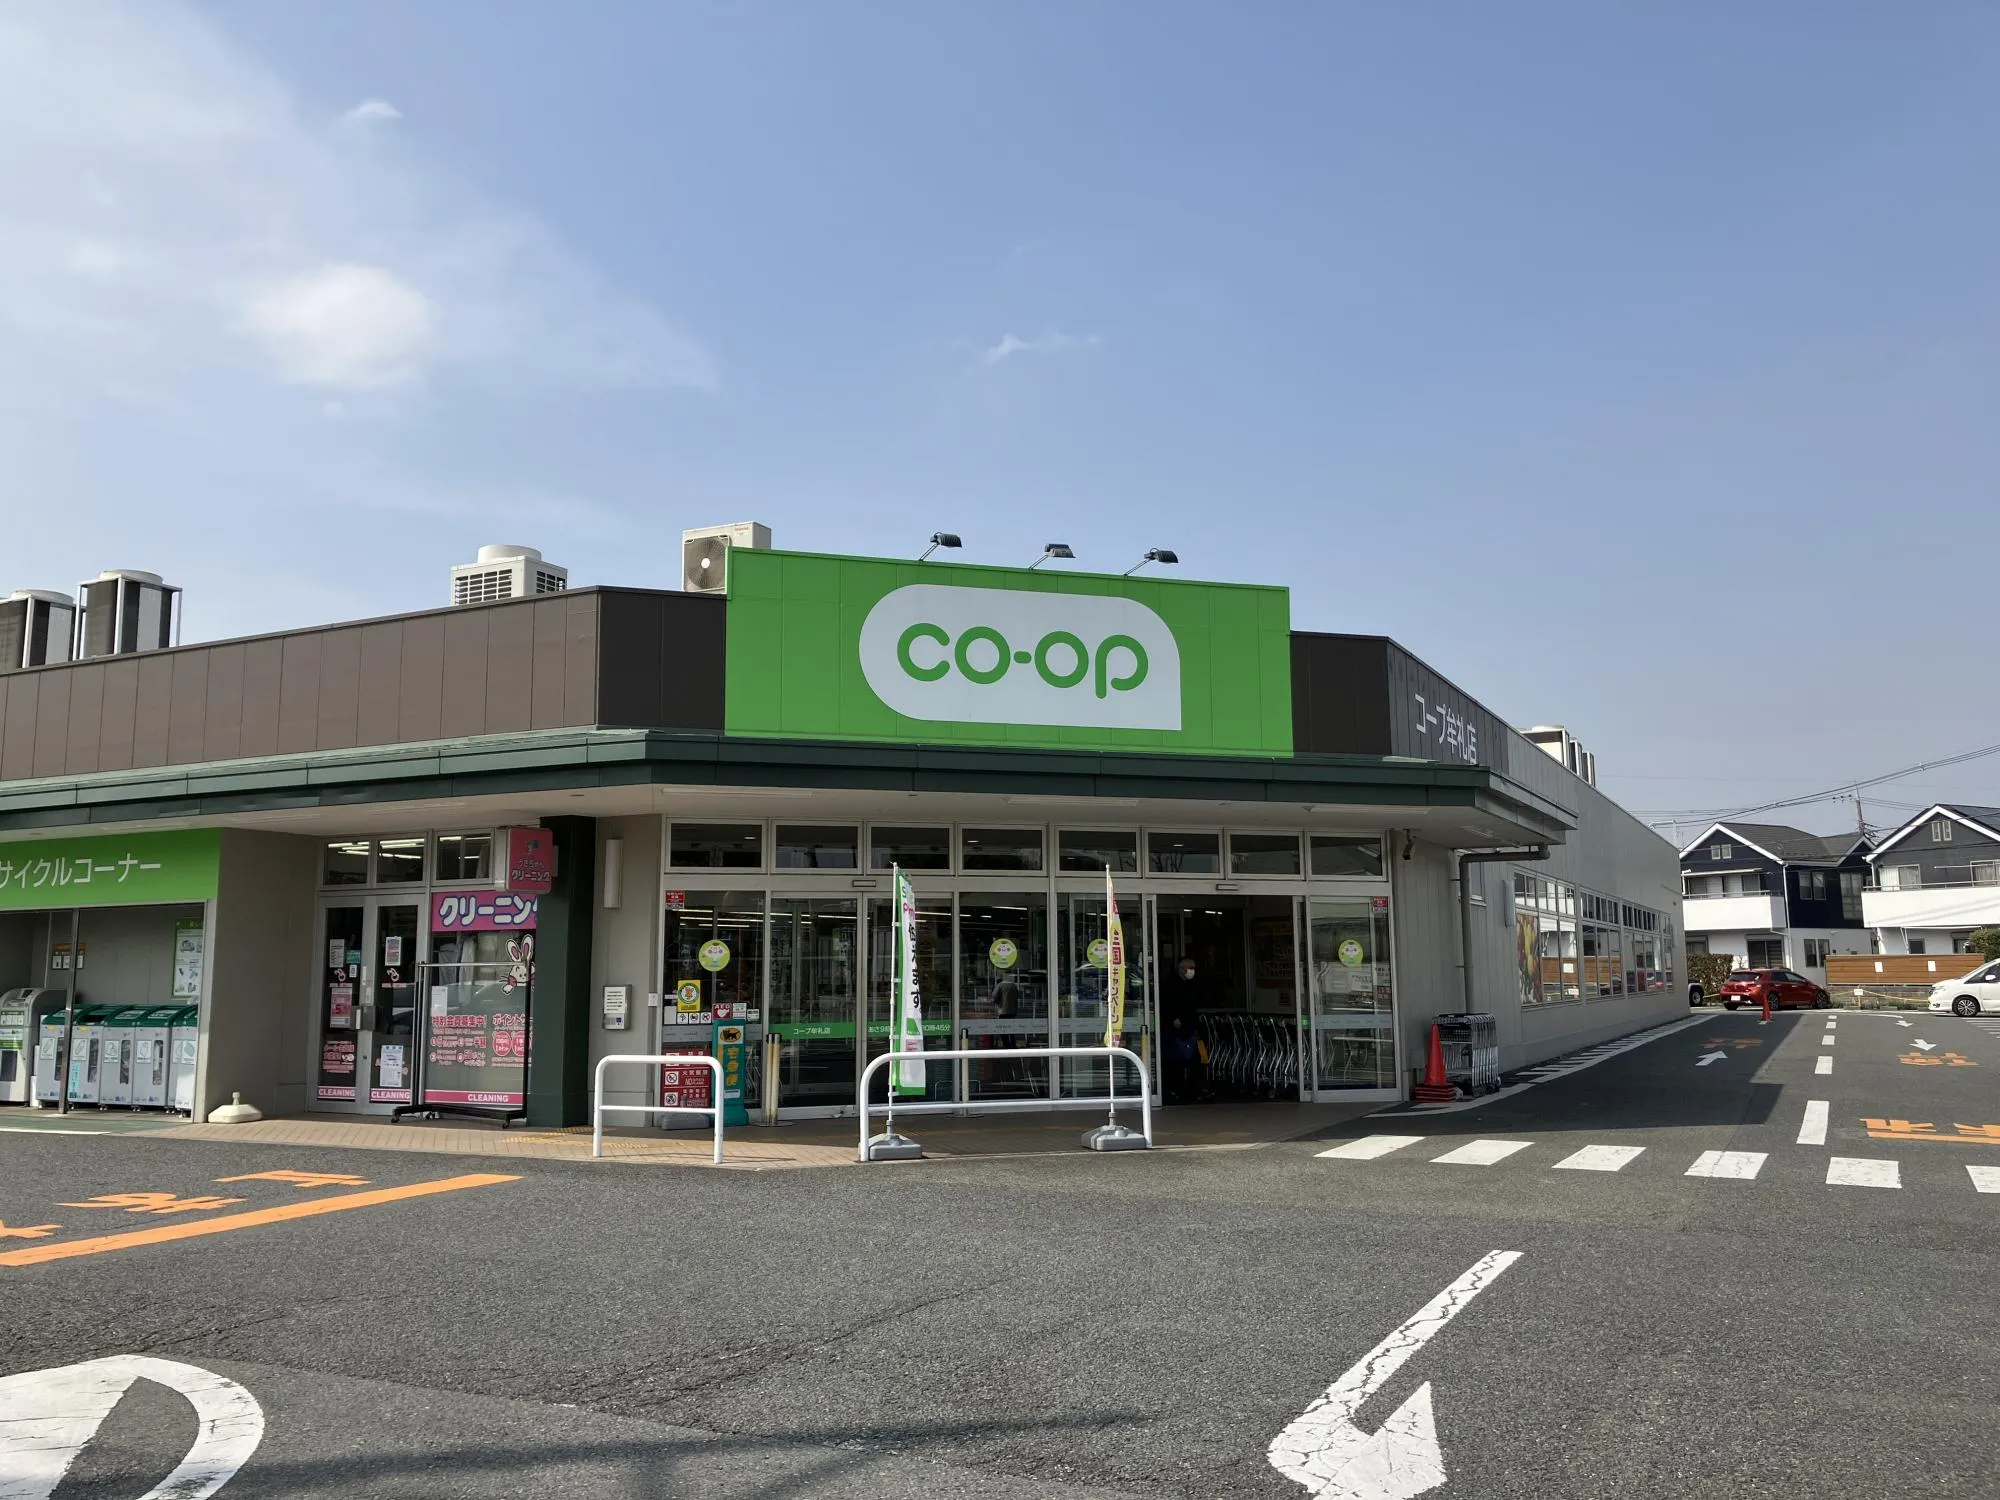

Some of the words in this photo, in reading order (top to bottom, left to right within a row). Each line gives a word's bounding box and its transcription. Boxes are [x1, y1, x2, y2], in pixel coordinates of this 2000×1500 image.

[1414, 693, 1476, 765] コープ牟礼店
[0, 853, 161, 889] サイクルコーナー
[439, 895, 538, 927] クリーニン
[318, 1088, 355, 1097] CLEANING
[371, 1090, 410, 1099] CLEANING
[467, 1093, 508, 1103] CLEANING
